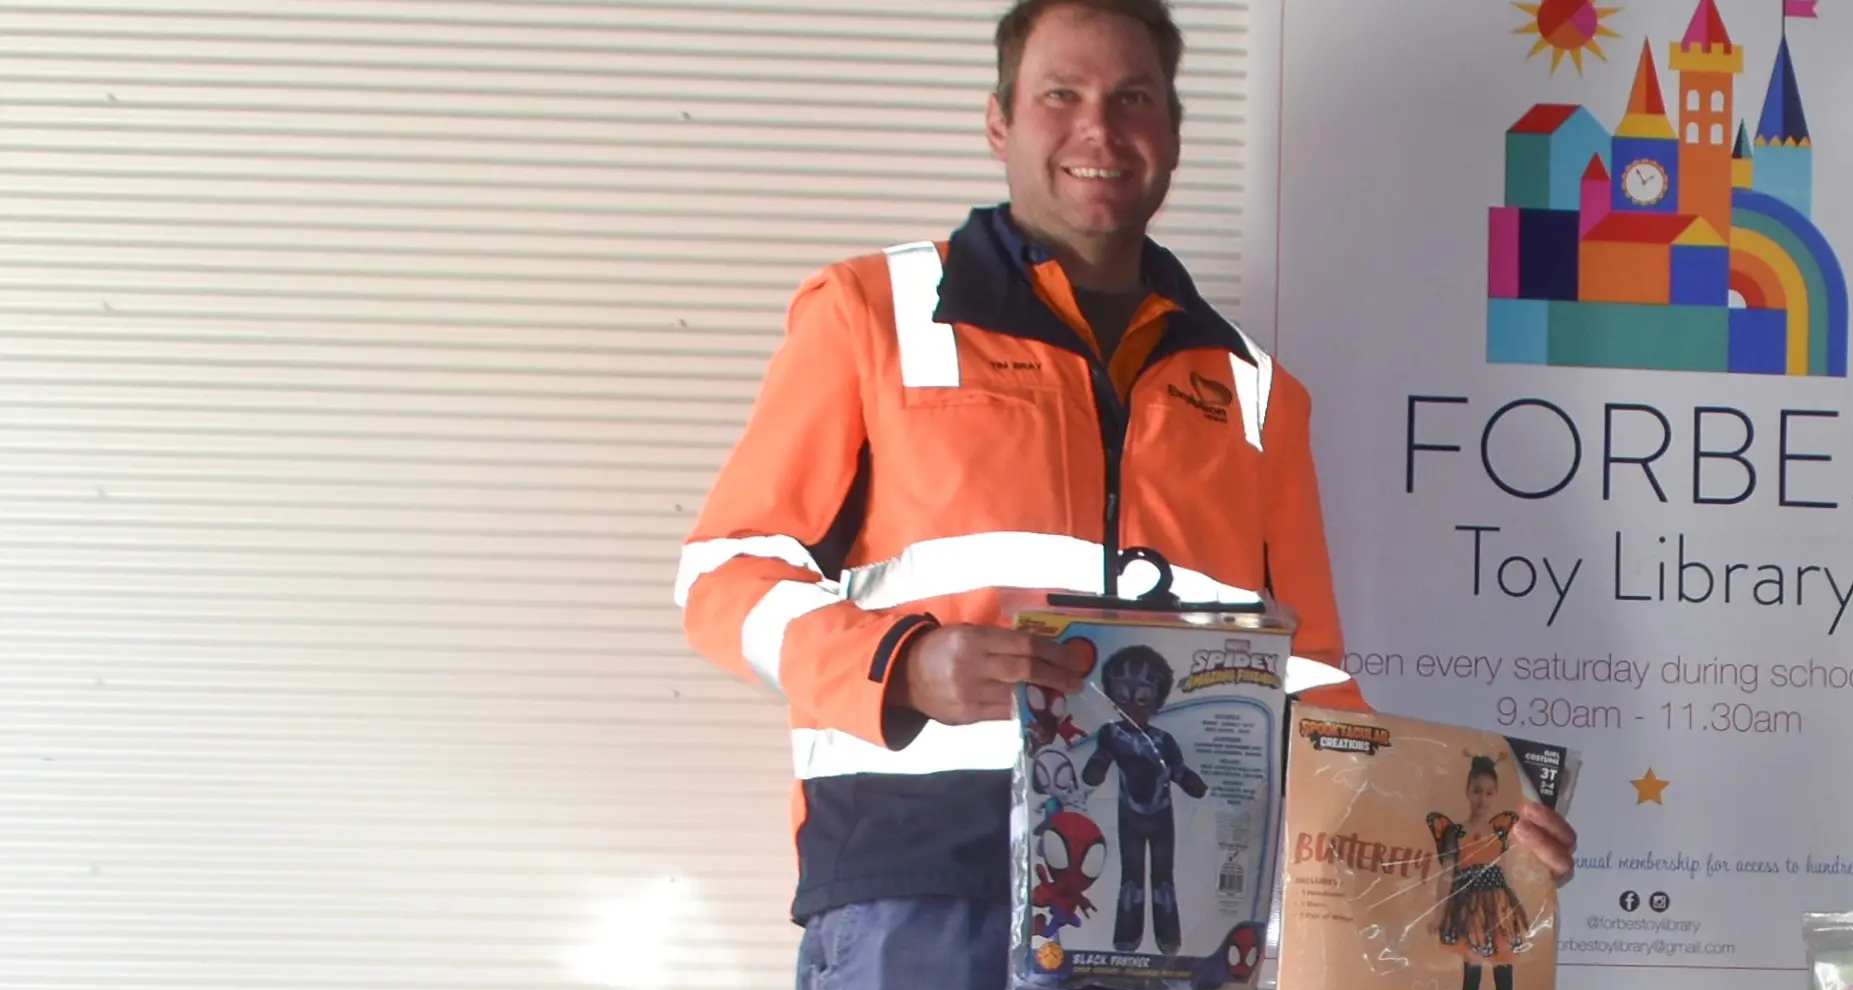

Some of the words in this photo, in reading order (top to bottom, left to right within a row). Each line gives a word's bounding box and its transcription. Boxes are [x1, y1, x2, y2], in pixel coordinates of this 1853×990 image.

[1455, 525, 1583, 626] Toy
[1190, 649, 1279, 675] SPIDEY
[1343, 651, 1404, 679] pen
[1416, 654, 1502, 686] every
[1514, 652, 1650, 690] saturday
[1661, 656, 1759, 694] during
[1497, 696, 1622, 728] 9.30am
[1661, 701, 1803, 733] 11.30am
[1319, 736, 1371, 751] CREATIONS
[1540, 768, 1558, 781] 3T
[1618, 851, 1701, 879] membership
[1706, 853, 1731, 878] for
[1737, 860, 1780, 874] access
[1786, 857, 1799, 874] to
[1587, 914, 1701, 935] @forbestoylibrary
[1557, 938, 1736, 957] orbestoylibrary@gmail.com
[1072, 954, 1107, 965] BLACK
[1110, 956, 1151, 968] PANTHER
